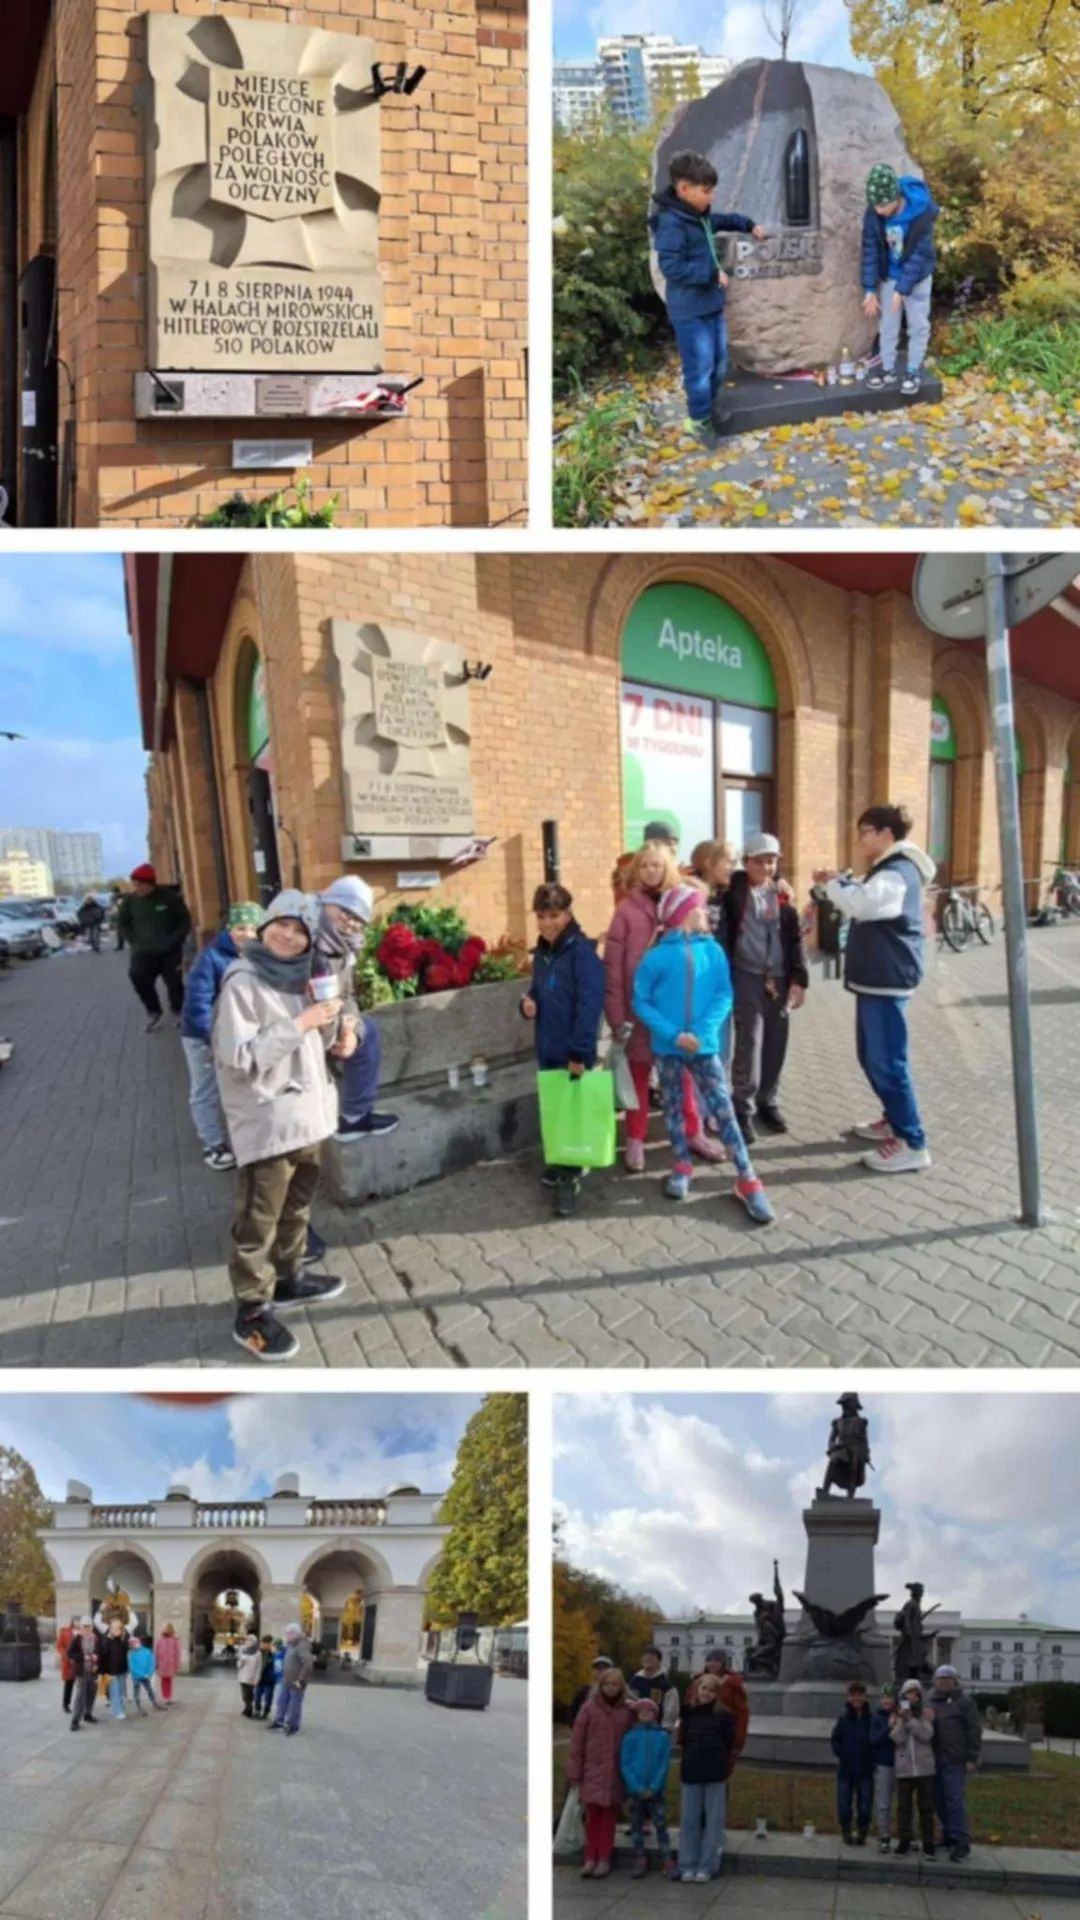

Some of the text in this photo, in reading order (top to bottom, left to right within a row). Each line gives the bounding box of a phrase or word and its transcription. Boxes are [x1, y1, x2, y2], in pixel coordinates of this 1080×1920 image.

[235, 75, 309, 97] MIEJSCE
[213, 162, 237, 180] ZA
[228, 182, 320, 204] OJCZYZNY
[189, 279, 198, 296] 7
[217, 281, 228, 298] 8
[235, 281, 313, 300] SIERPNIA
[318, 285, 353, 302] 1944
[168, 298, 373, 320] W HALACH MIROWSKICH
[163, 317, 379, 339] HITLEROWCY ROZSTRZELALI
[213, 337, 243, 353] 510
[657, 617, 742, 669] Apteka
[622, 691, 704, 737] 7 DNI
